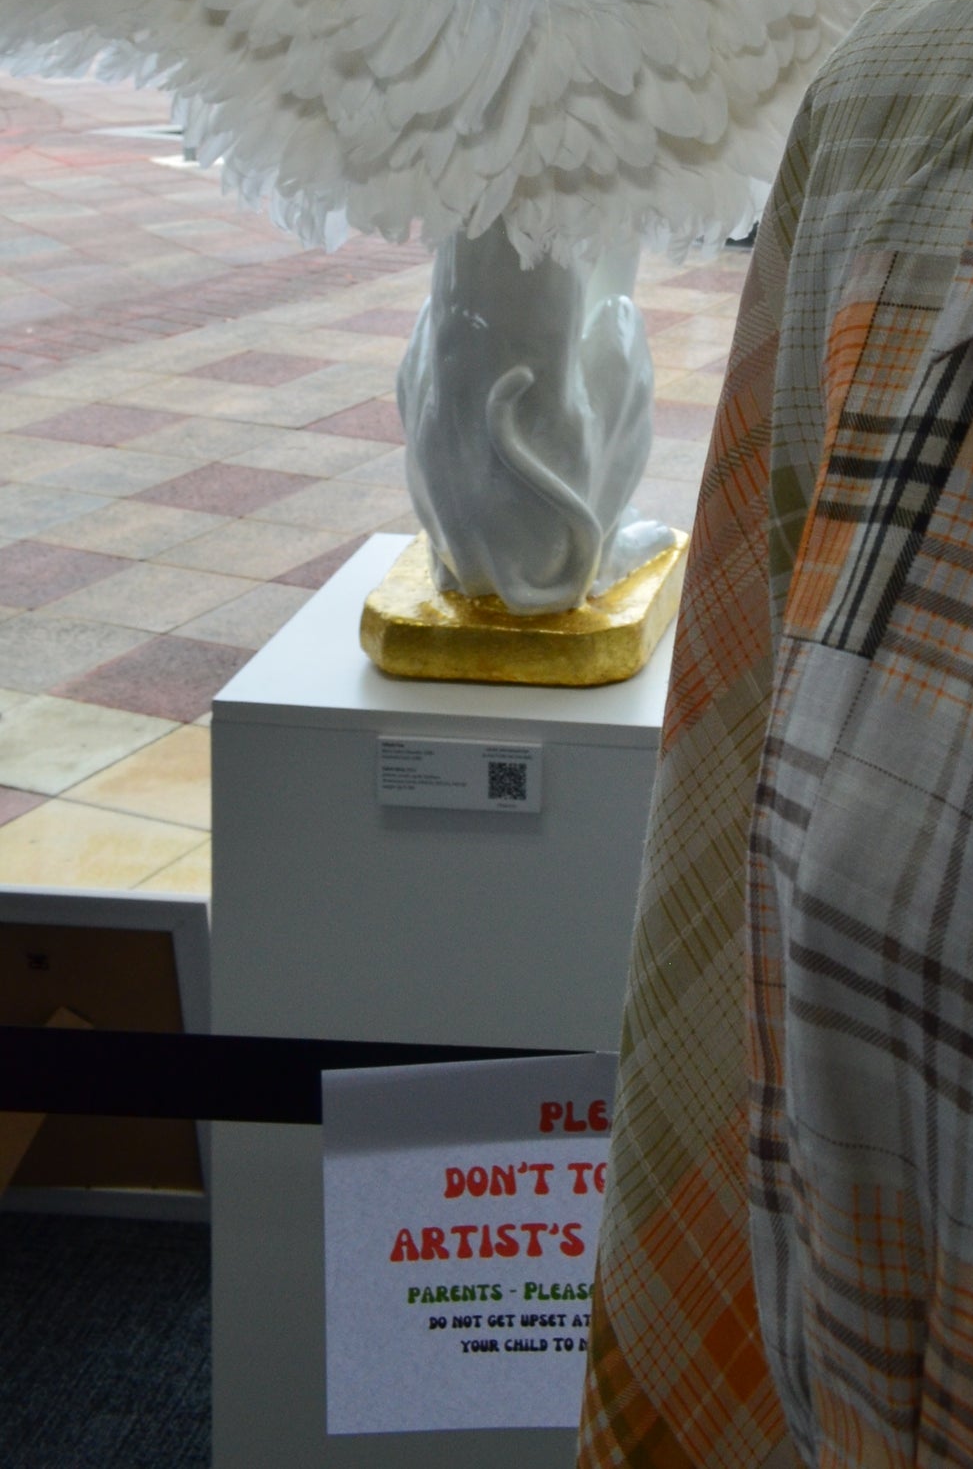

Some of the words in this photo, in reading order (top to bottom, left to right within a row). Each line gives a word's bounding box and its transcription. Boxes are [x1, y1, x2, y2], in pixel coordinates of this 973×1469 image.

[539, 1099, 612, 1132] PLE
[443, 1161, 554, 1199] DON'T
[389, 1222, 585, 1262] ARTIST'S
[407, 1284, 503, 1304] PARENTS
[429, 1316, 447, 1329] DO
[452, 1315, 482, 1328] NOT
[487, 1314, 515, 1328] GET
[521, 1314, 567, 1327] UPSET
[461, 1339, 500, 1353] YOUR
[504, 1338, 548, 1352] CHiLD
[553, 1337, 574, 1351] TO
